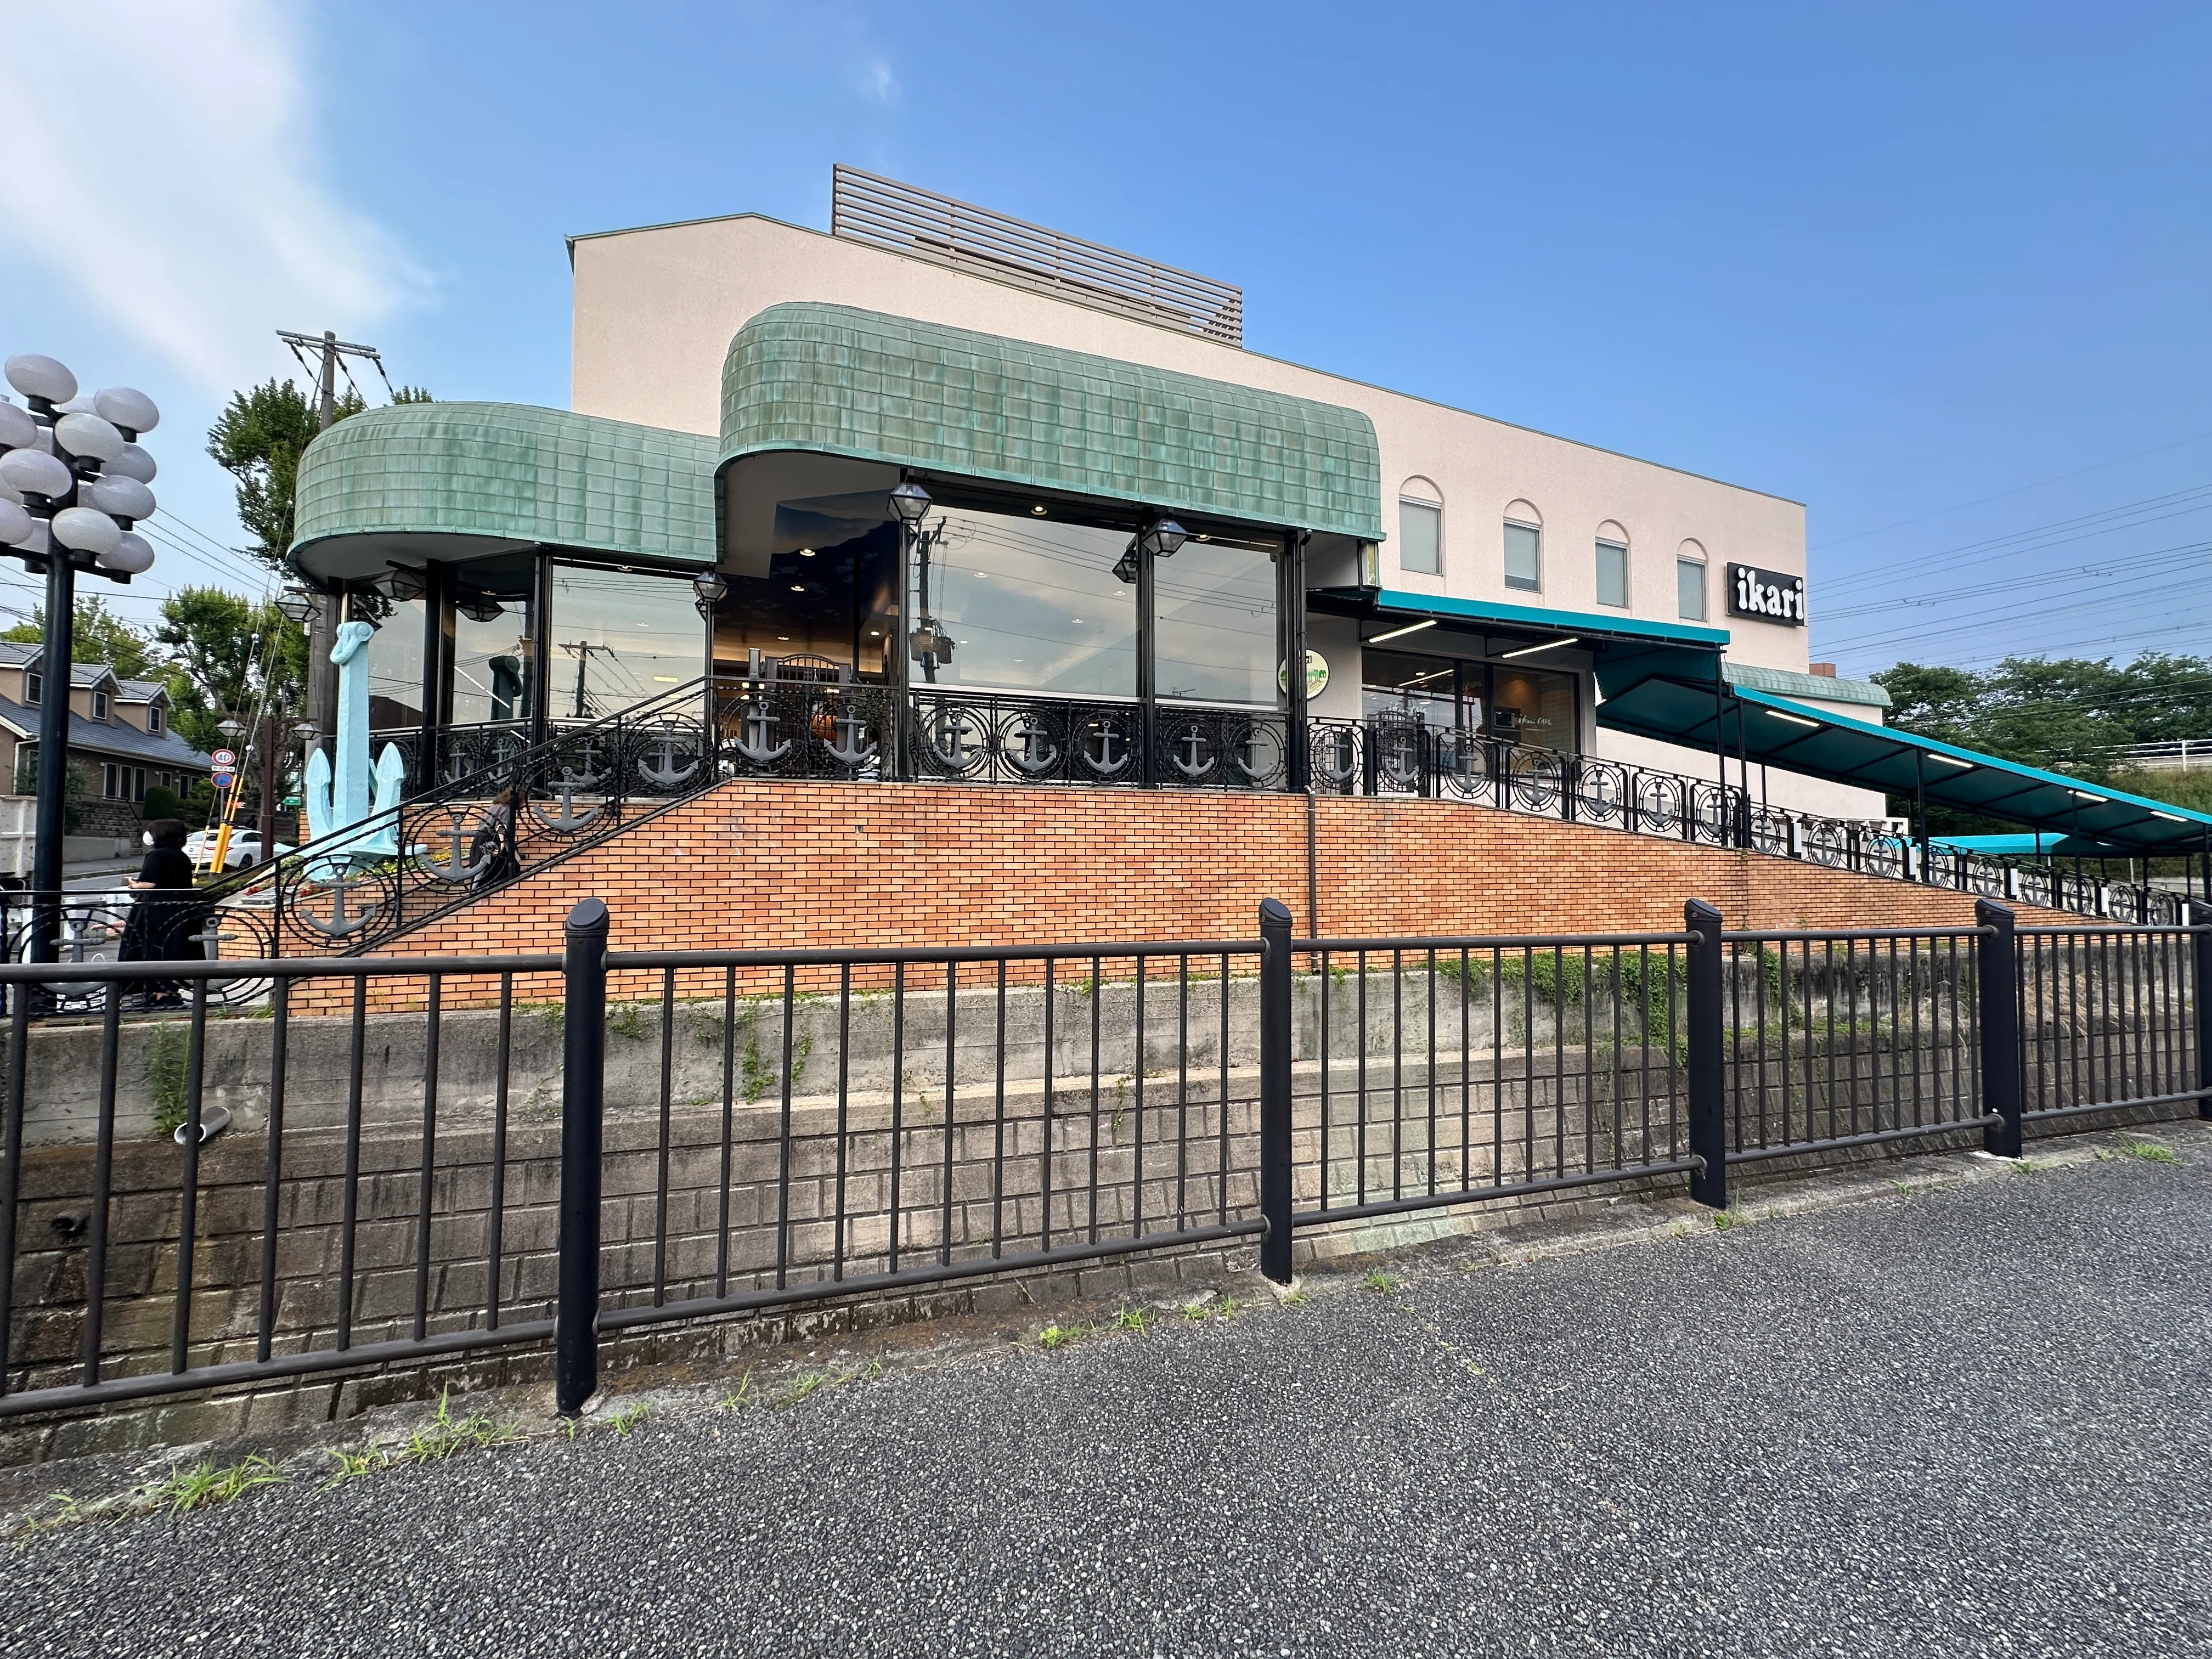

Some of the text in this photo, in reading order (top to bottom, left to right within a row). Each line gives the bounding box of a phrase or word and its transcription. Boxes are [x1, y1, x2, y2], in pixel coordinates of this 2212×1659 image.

[1737, 567, 1804, 620] ikari
[1518, 714, 1553, 725] ikari CAFE
